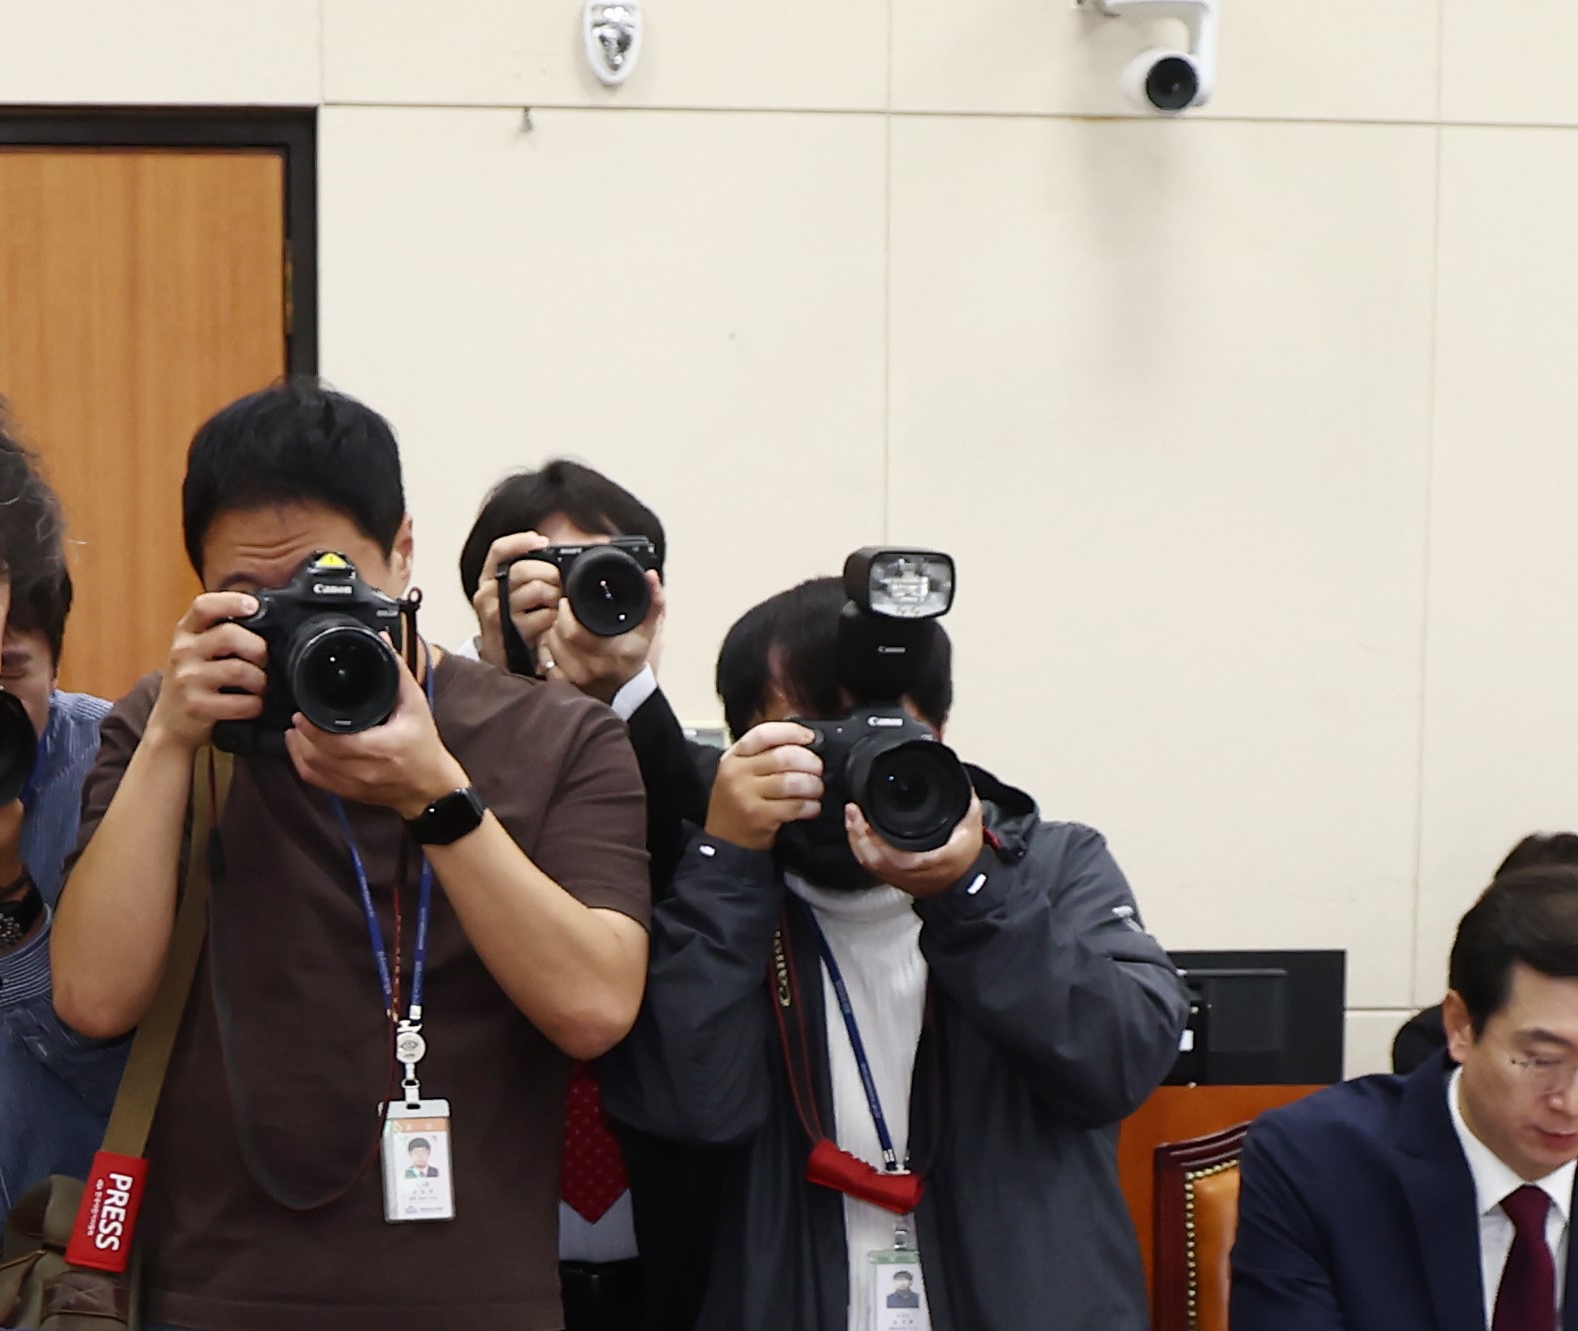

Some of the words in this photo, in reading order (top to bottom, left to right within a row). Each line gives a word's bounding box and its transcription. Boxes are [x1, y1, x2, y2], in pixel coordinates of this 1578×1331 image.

[313, 583, 353, 594] Canon
[867, 716, 904, 727] Canon
[94, 1172, 135, 1252] PRESS
